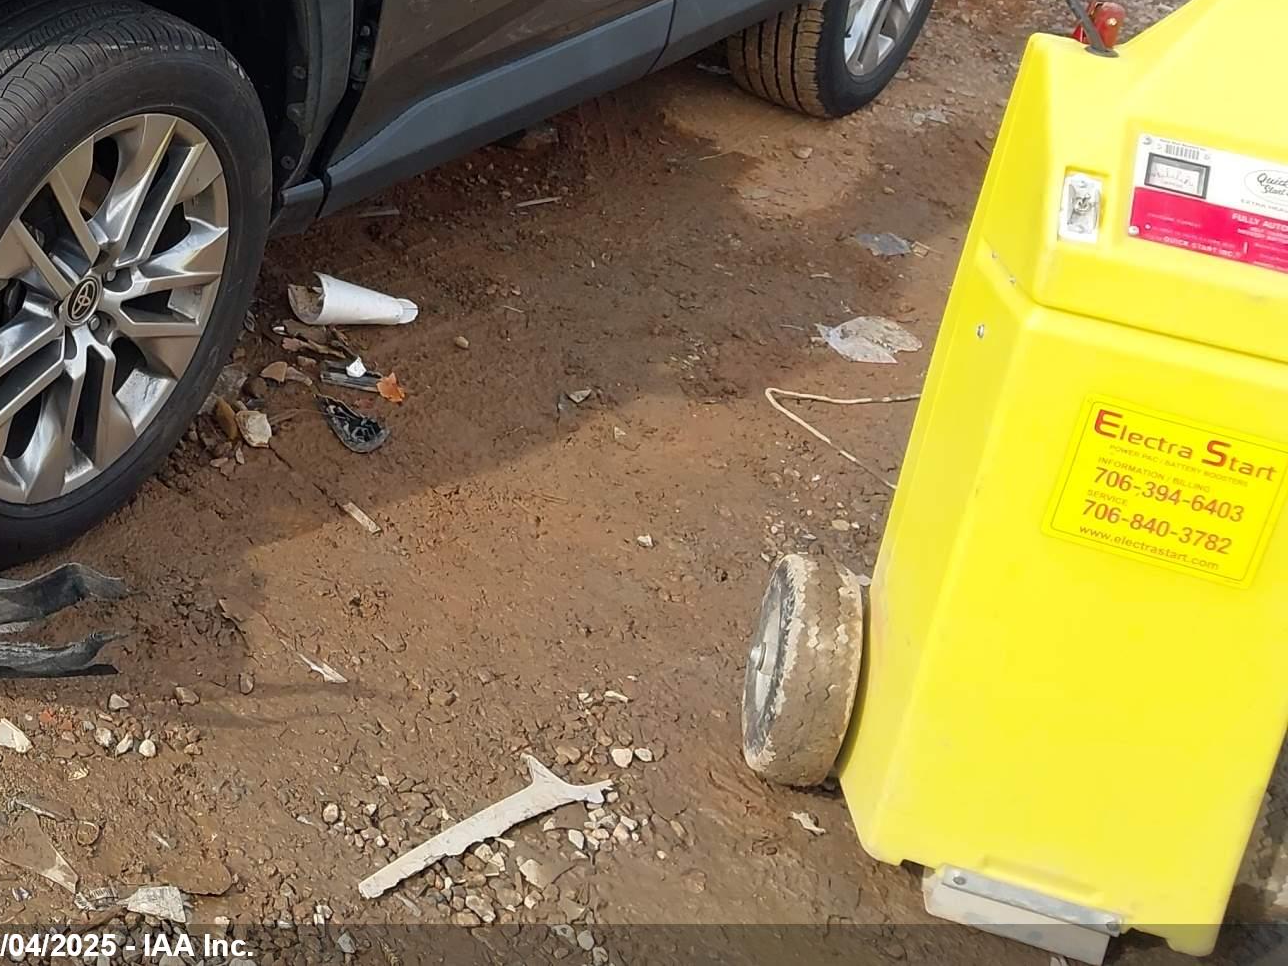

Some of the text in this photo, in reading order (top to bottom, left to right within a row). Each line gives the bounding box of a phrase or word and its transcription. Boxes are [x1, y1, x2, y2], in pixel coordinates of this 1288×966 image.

[1231, 212, 1261, 226] FULLY
[1093, 408, 1278, 482] Electra Start
[1097, 456, 1165, 481] INFORMATION
[1172, 476, 1211, 494] BILLING
[1164, 458, 1202, 475] BATTERY
[1087, 489, 1128, 507] SERVICE
[1092, 466, 1245, 523] 706-394-6403
[1079, 524, 1220, 571] www.electrastart.com
[1081, 498, 1233, 555] 706-840-3782
